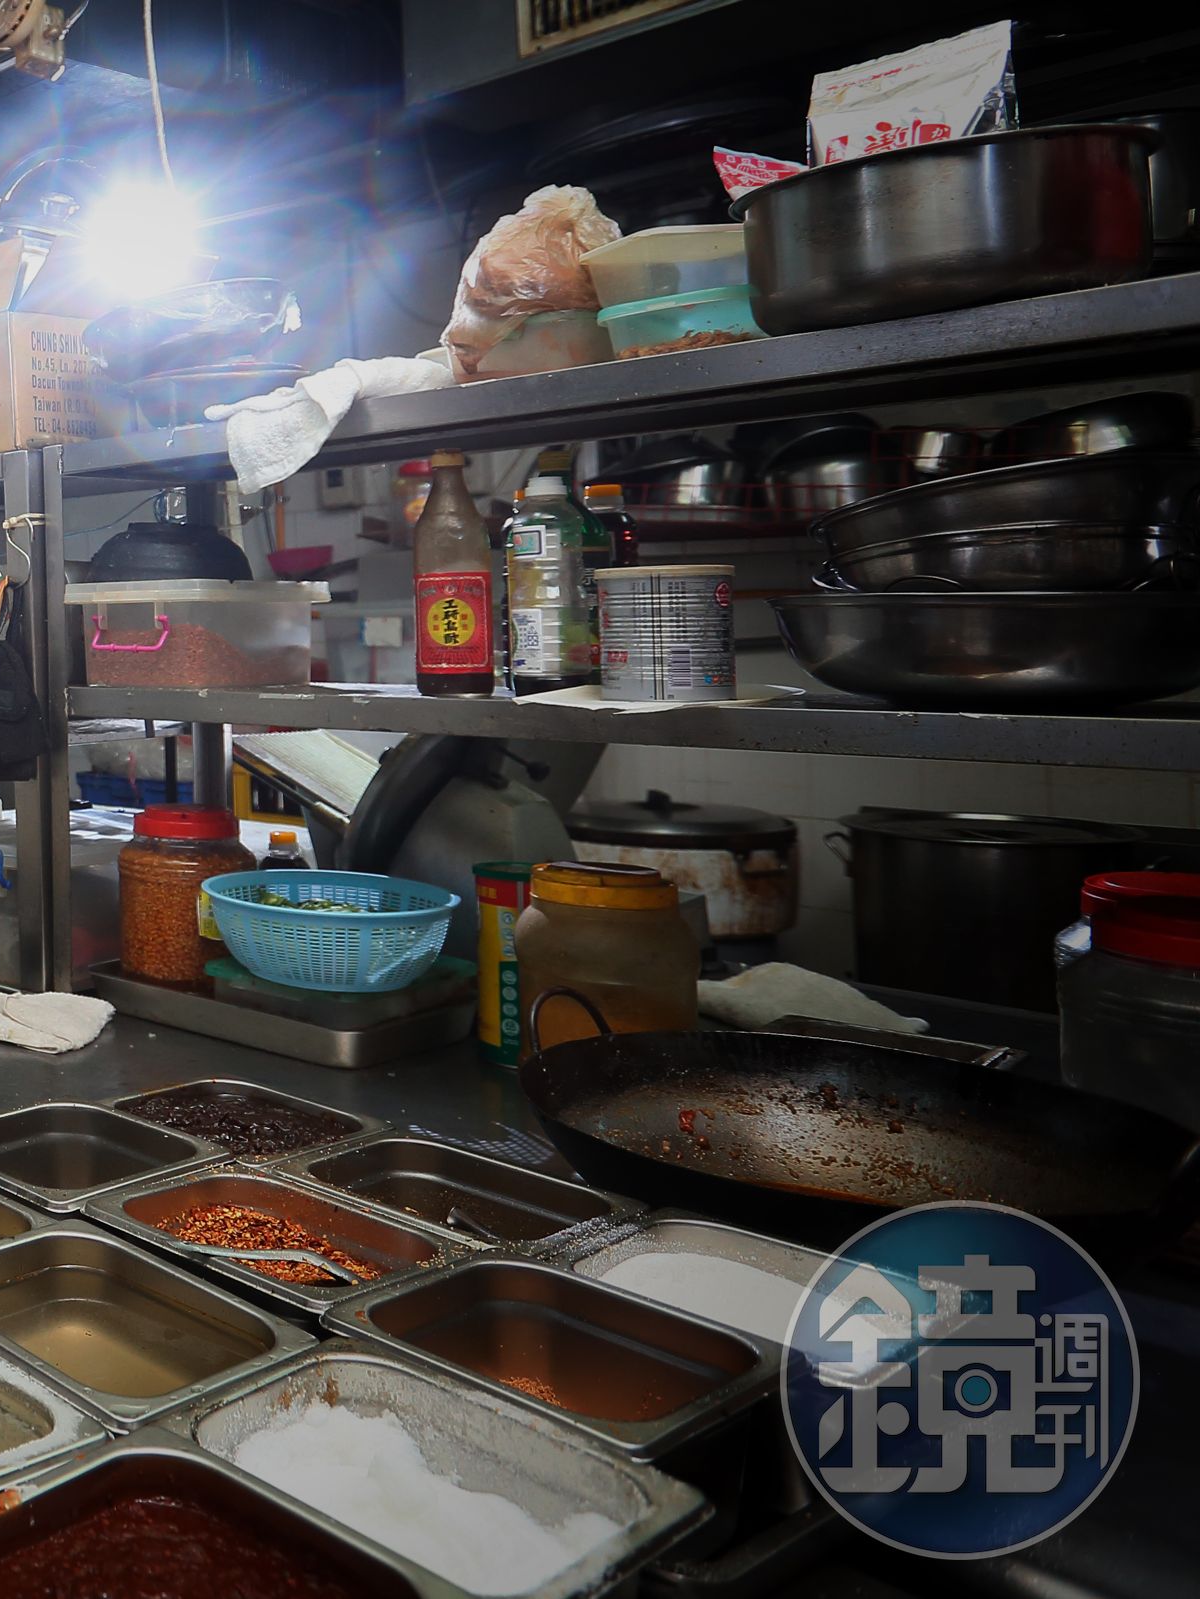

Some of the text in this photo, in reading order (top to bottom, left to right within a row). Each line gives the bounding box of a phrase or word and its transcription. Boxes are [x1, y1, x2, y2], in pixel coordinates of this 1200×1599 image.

[31, 331, 57, 354] CHUNG
[59, 334, 79, 355] SHIN
[31, 374, 57, 390] Dacun
[32, 396, 61, 412] Taiwan
